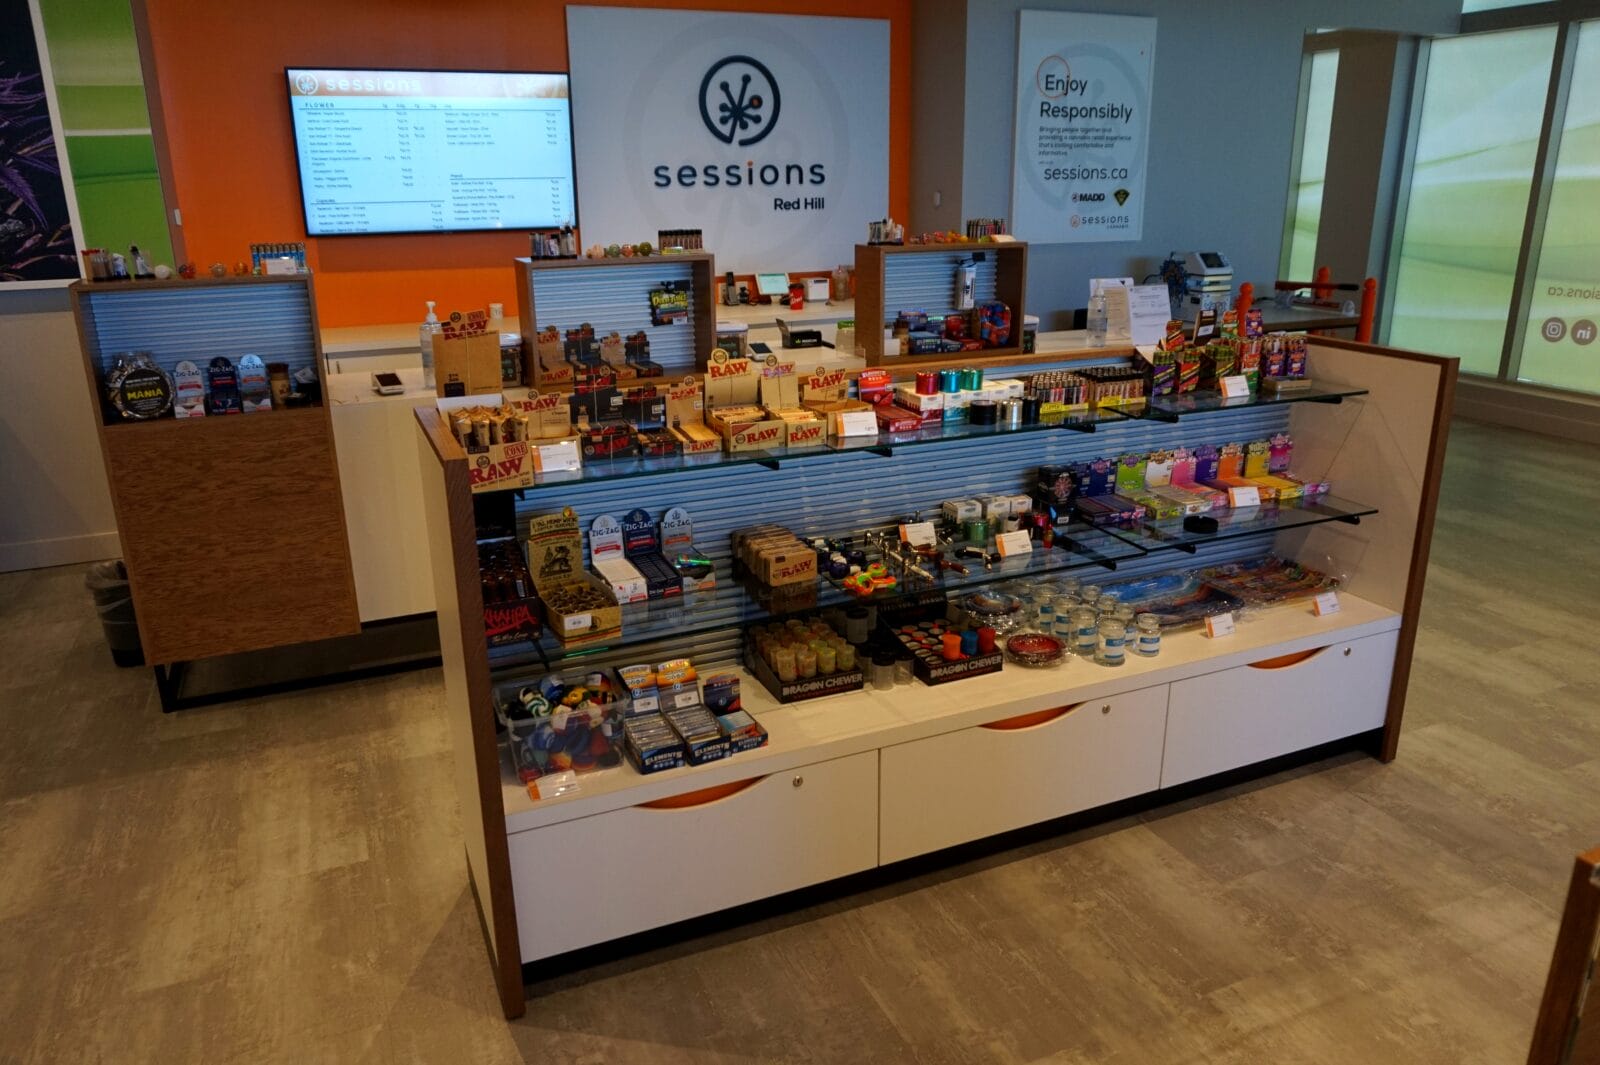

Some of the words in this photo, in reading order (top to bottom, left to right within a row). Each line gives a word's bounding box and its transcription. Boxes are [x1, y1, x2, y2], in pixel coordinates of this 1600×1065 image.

[325, 77, 422, 93] sessions
[1045, 74, 1088, 96] Enjoy
[1040, 101, 1132, 123] Responsibly
[654, 160, 826, 187] sessions
[1044, 164, 1128, 180] sessions.ca
[774, 198, 800, 210] Red
[804, 197, 825, 210] Hill
[1081, 215, 1129, 225] sessions
[442, 320, 488, 340] RAW
[710, 361, 749, 378] RAW
[763, 362, 794, 377] RAW
[811, 372, 844, 390] RAW
[127, 388, 163, 400] MANIA
[523, 398, 558, 412] RAW
[747, 427, 779, 443] RAW
[790, 427, 821, 442] RAW
[469, 457, 524, 484] RAW
[626, 521, 653, 530] ZIG-ZAG
[664, 519, 690, 528] ZIG-ZAG
[592, 527, 620, 537] ZIG-ZAG
[930, 663, 967, 678] DRAGON
[968, 655, 1002, 670] CHEWER
[783, 680, 824, 696] DRAGON
[825, 673, 862, 687] CHEWER
[695, 743, 730, 757] ELEMENTS
[645, 751, 683, 766] ELEMENTS
